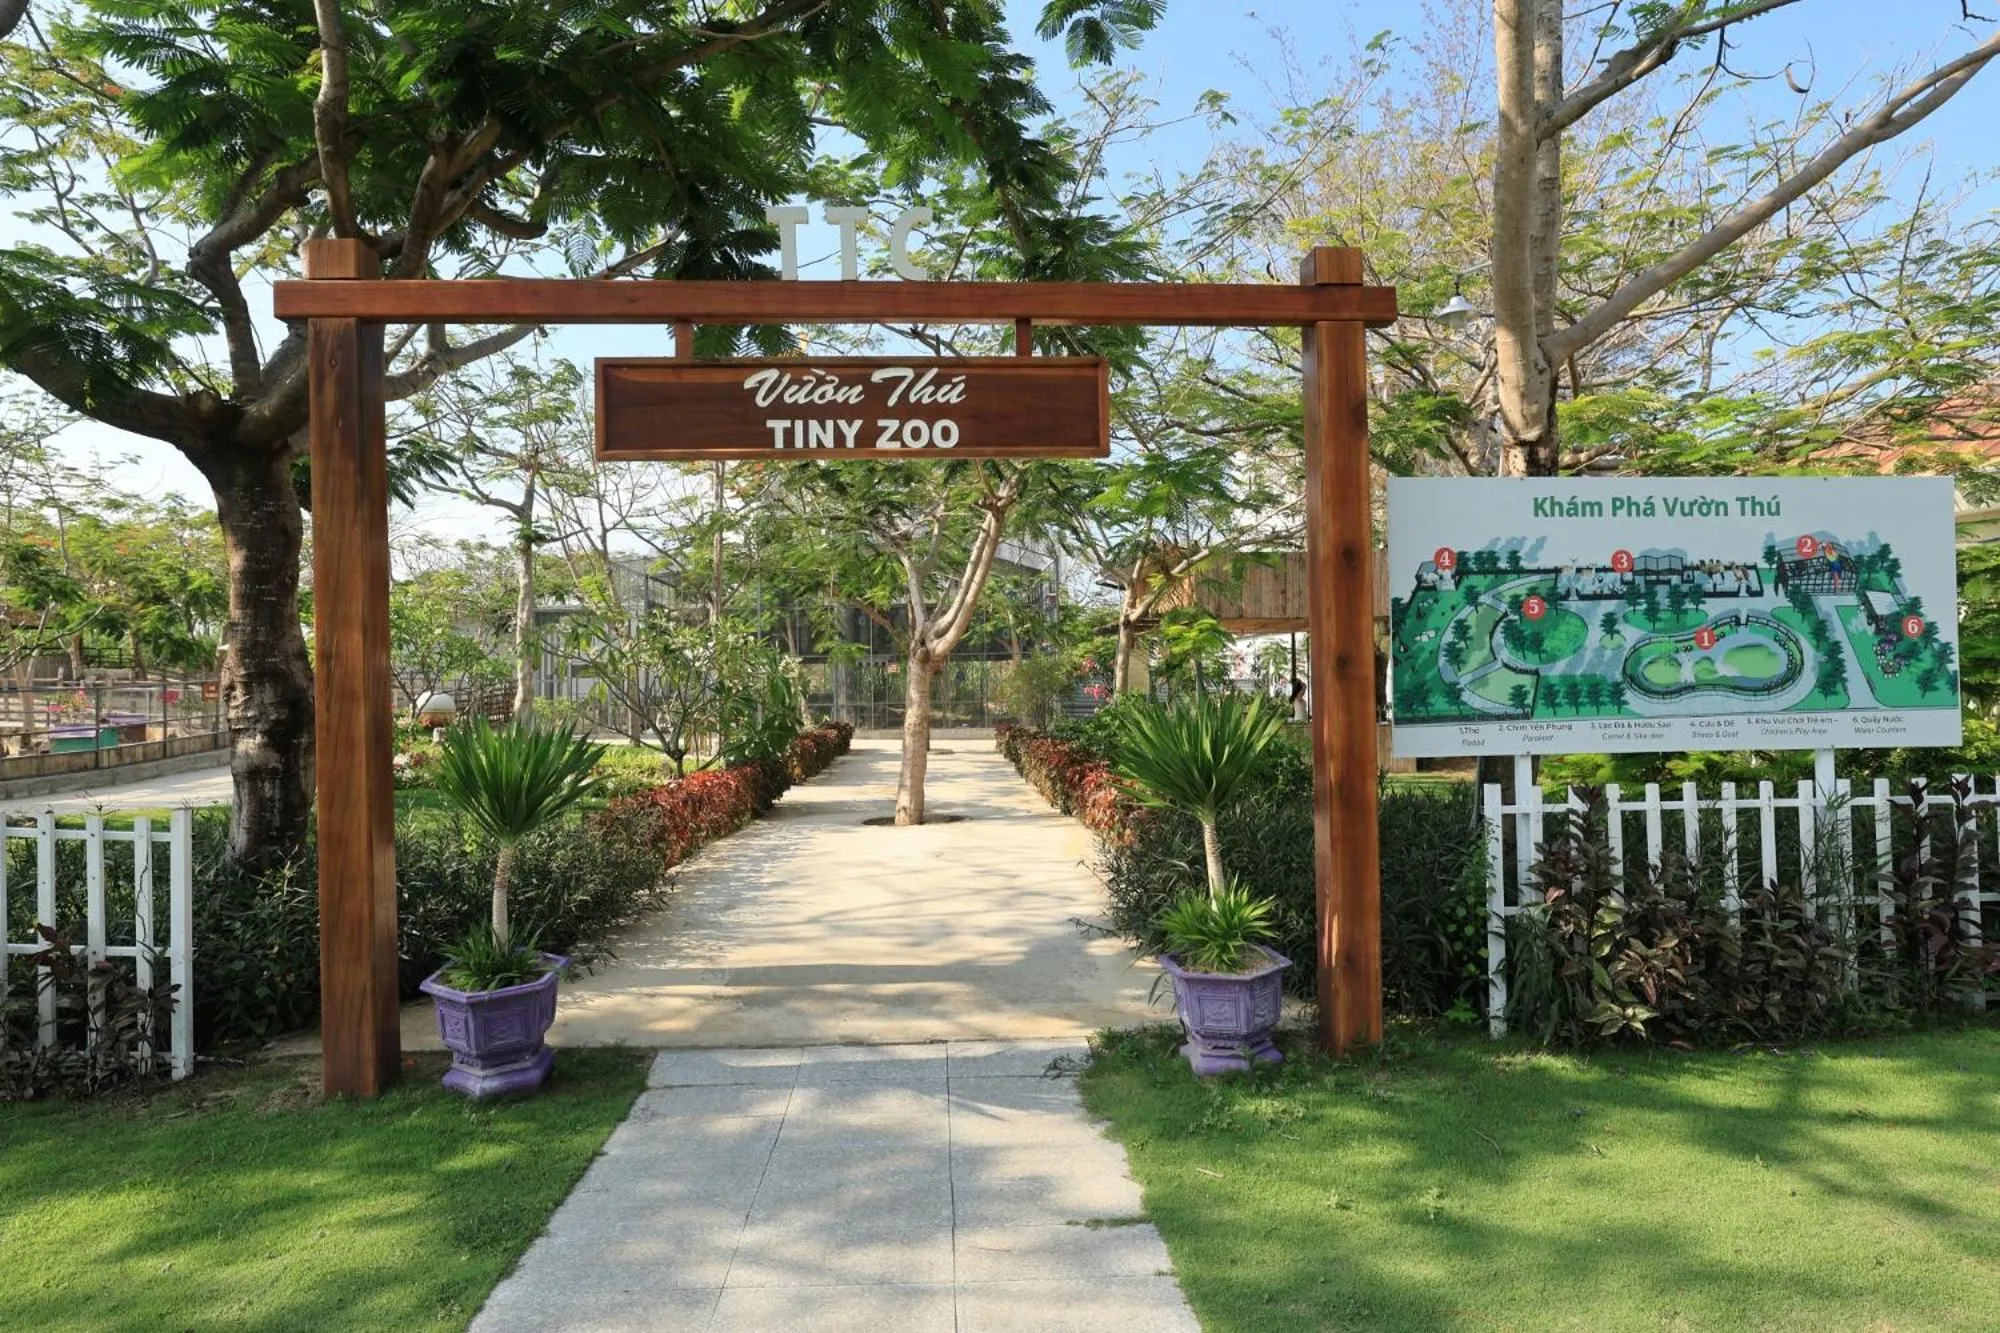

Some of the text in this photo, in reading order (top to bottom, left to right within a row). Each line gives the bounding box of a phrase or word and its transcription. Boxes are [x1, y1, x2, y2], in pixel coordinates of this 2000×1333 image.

[766, 206, 932, 281] TTC
[744, 367, 966, 407] Vườn Thú
[766, 419, 960, 449] TINY ZOO
[1533, 495, 1781, 518] Khám Phá Vườn Thú
[1802, 538, 1812, 553] 2
[1439, 551, 1450, 567] 4
[1618, 553, 1628, 568] 3
[1528, 600, 1540, 614] 5
[1907, 620, 1918, 635] 6
[1701, 632, 1711, 647] 1
